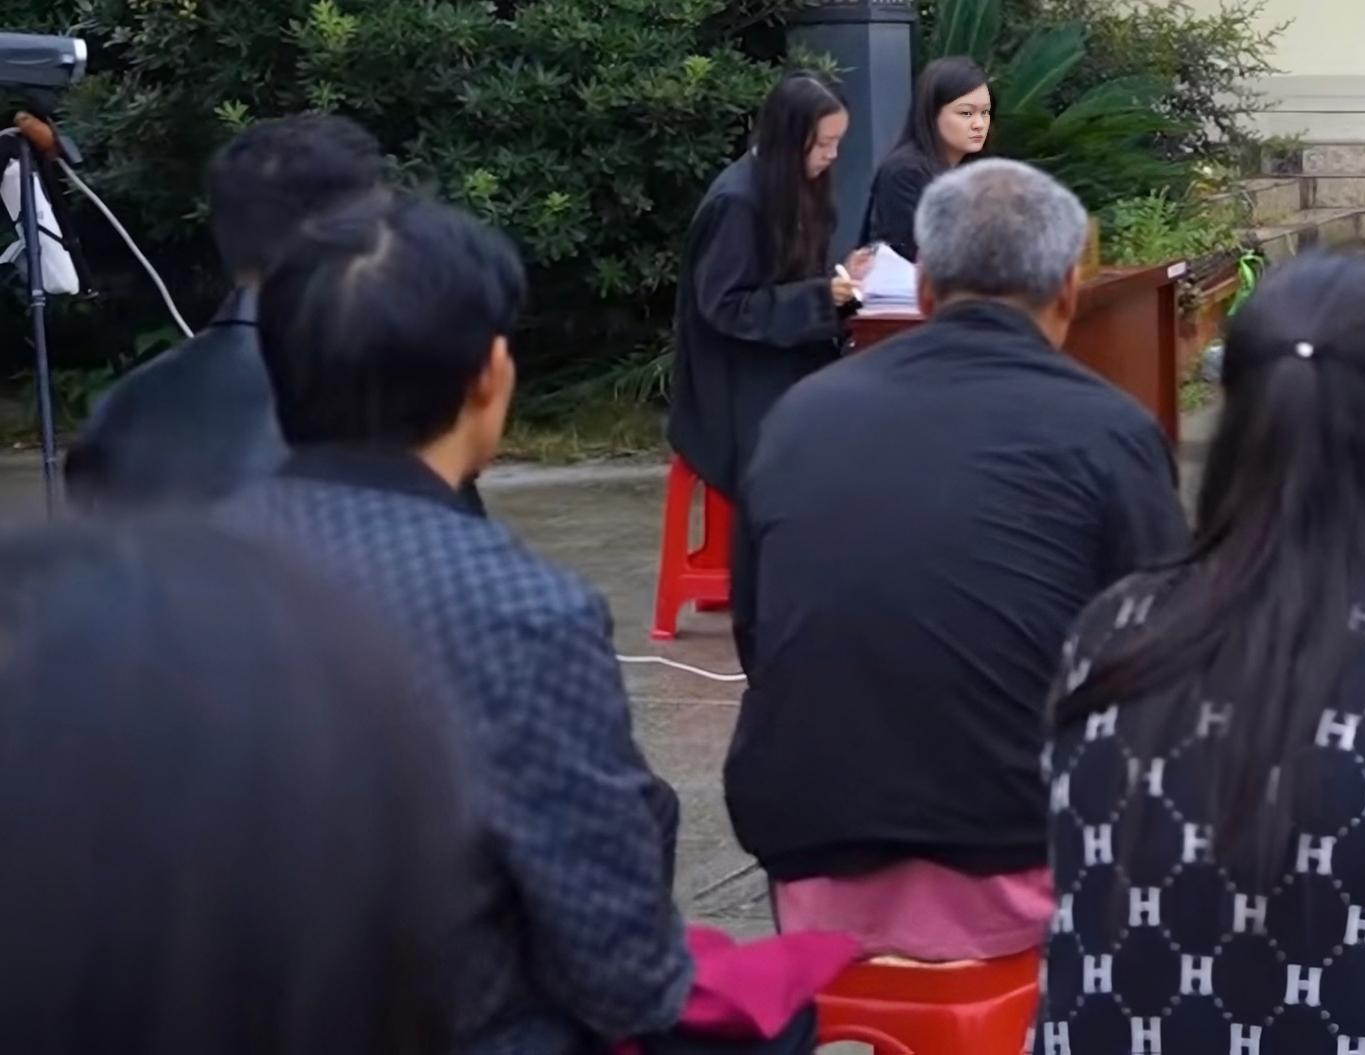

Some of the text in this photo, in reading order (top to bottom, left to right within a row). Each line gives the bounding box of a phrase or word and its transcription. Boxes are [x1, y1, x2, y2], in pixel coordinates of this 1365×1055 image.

[1115, 595, 1154, 629] H
[1085, 705, 1119, 741] H
[1314, 708, 1361, 751] H
[1083, 823, 1114, 866] H
[1182, 822, 1215, 864] H
[1296, 833, 1337, 875] H
[1129, 887, 1160, 927] H
[1232, 893, 1268, 934] H
[1083, 953, 1113, 994] H
[1180, 953, 1214, 996] H
[1284, 964, 1322, 1007] H
[1044, 1021, 1071, 1055] H
[1131, 1016, 1162, 1055] H
[1229, 1023, 1262, 1055] H
